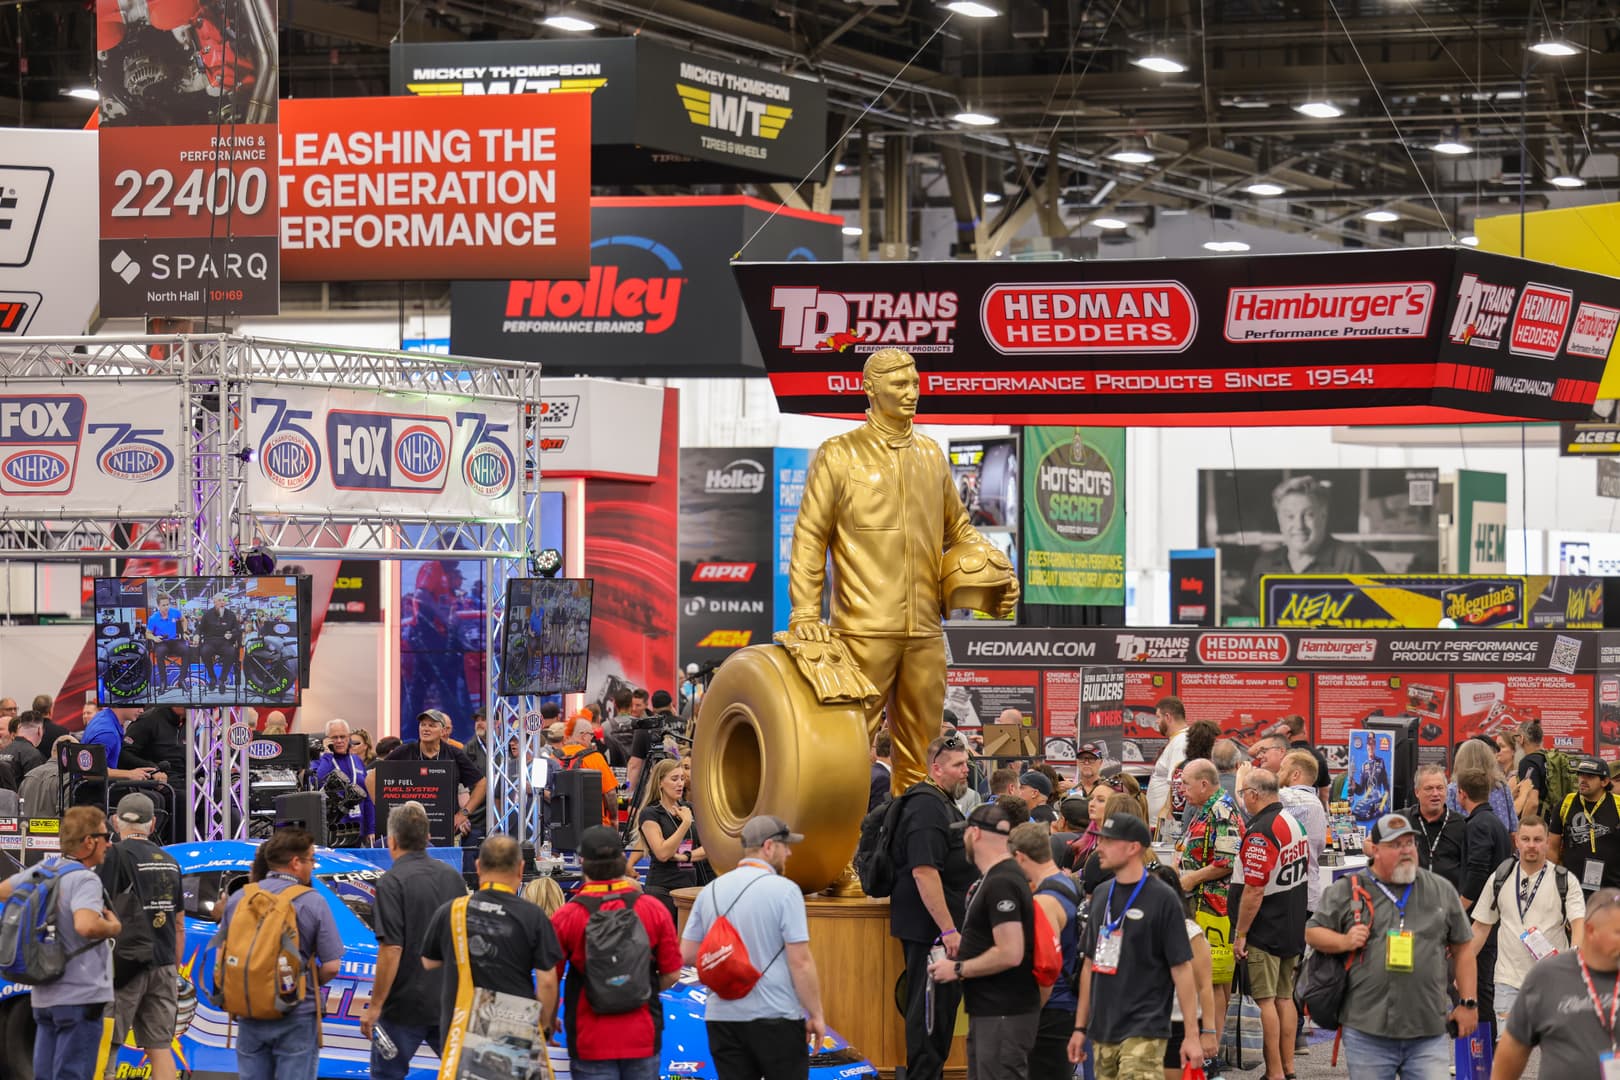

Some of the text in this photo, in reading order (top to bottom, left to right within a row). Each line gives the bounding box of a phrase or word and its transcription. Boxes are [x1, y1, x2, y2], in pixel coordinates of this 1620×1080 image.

[413, 64, 601, 81] MICKEY THOMPSON
[680, 62, 790, 101] MICKEY THOMPSON
[709, 92, 768, 137] M/T
[210, 136, 266, 148] RACING &
[478, 127, 557, 162] THE
[701, 136, 727, 152] TIRES
[734, 144, 767, 159] WHEELS
[180, 150, 266, 162] PERFORMANCE
[111, 167, 268, 218] 22400
[303, 169, 557, 209] GENERATION
[151, 252, 268, 281] SPARQ
[147, 290, 176, 303] North
[178, 290, 200, 302] Hall
[847, 292, 959, 320] TRANS
[1003, 291, 1171, 320] HEDMAN
[1234, 285, 1425, 323] Hamburger's
[1480, 284, 1516, 315] TRANS
[1521, 294, 1568, 326] HEDMAN
[503, 320, 645, 334] PERFORMANCE BRANDS
[856, 320, 956, 343] DAPT
[1244, 324, 1410, 340] Performance Products
[1475, 313, 1507, 340] DAPT
[1514, 324, 1560, 349] HEDDERS
[1574, 309, 1617, 342] Hamburger's
[912, 345, 951, 353] PRODUCTS
[928, 367, 1374, 393] PERFORMANCE PRODUCTS SINCE 1954!
[1494, 375, 1555, 398] WWW.HEDMAN.COM
[0, 402, 71, 438] FOX
[88, 423, 175, 483] 75
[250, 396, 322, 493] 75
[337, 423, 441, 477] FOX NHRA
[455, 411, 516, 500] 75
[12, 454, 60, 482] NHRA
[113, 451, 155, 473] NHRA
[272, 443, 307, 476] NHRA
[473, 455, 503, 484] NHRA
[705, 468, 765, 493] Holley
[1041, 465, 1068, 492] HOT
[1049, 493, 1104, 523] SECRET
[699, 565, 750, 578] APR
[710, 600, 764, 613] DINAN
[1281, 592, 1354, 619] NEW
[1447, 584, 1516, 620] Meguiar's
[698, 630, 753, 647] AEM
[967, 641, 1096, 657] HEDMAN.COM
[1147, 637, 1190, 649] TRANS
[1206, 637, 1280, 650] HEDMAN
[1301, 640, 1374, 653] Hamburger's
[1389, 641, 1539, 651] QUALITY PERFORMANCE
[1149, 648, 1187, 659] DAPT
[1206, 650, 1279, 660] HEDDERS
[1392, 652, 1536, 662] PRODUCTS SINCE 1954!
[1082, 682, 1124, 702] BUILDERS
[231, 726, 249, 745] NHRA
[1554, 737, 1573, 746] USA
[249, 743, 277, 757] NHRA
[1245, 852, 1268, 862] FORCE
[1247, 846, 1266, 856] JOHN
